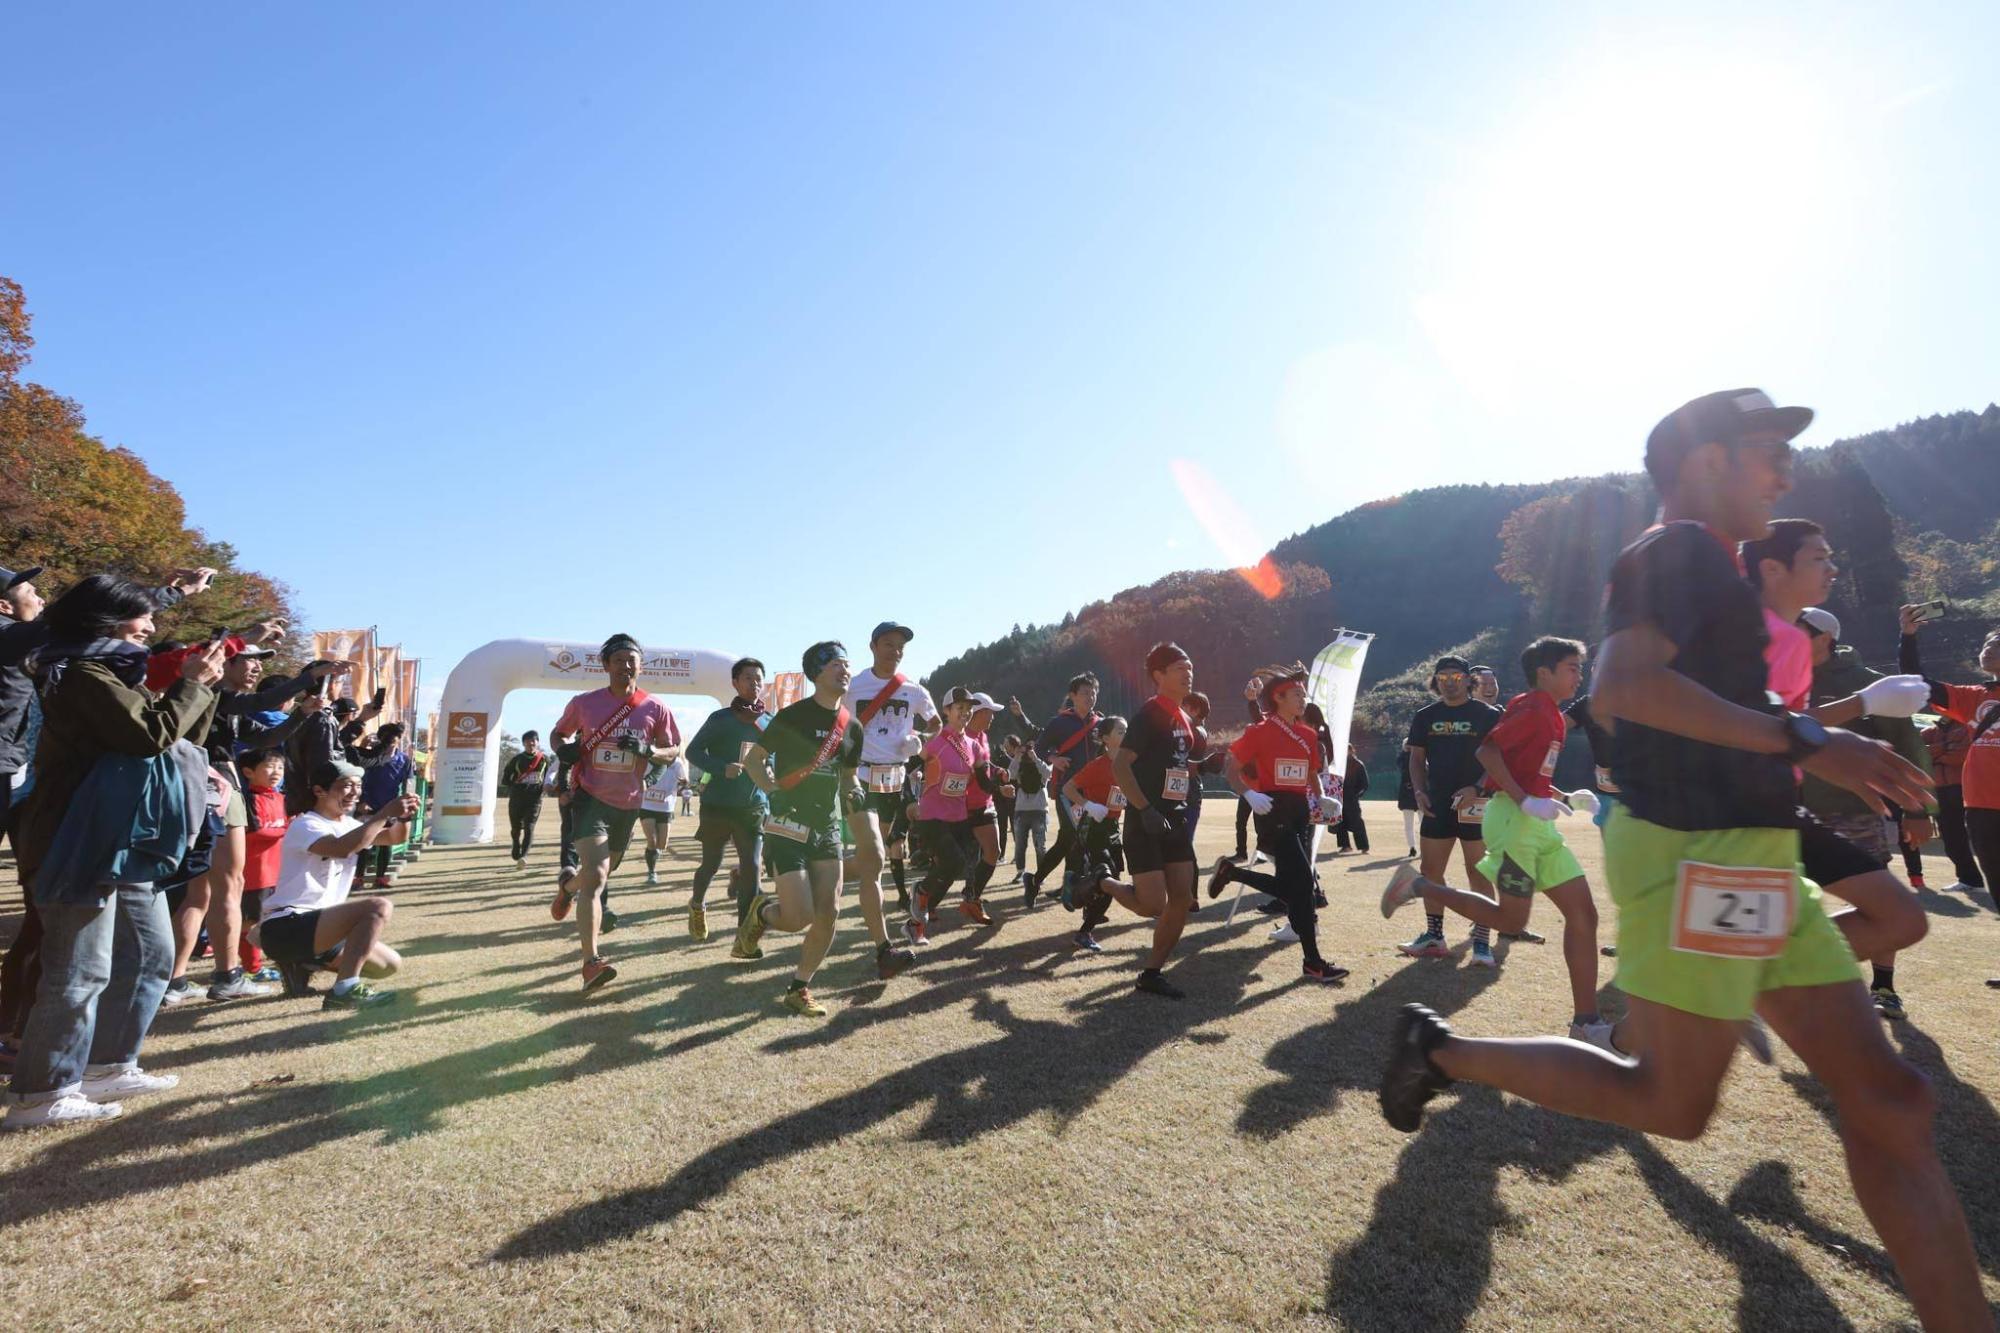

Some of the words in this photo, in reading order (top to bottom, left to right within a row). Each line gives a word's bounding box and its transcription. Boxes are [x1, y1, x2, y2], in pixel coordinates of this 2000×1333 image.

[603, 750, 625, 763] 8-1
[1283, 766, 1302, 777] 17-1
[1711, 893, 1770, 929] 2-1
